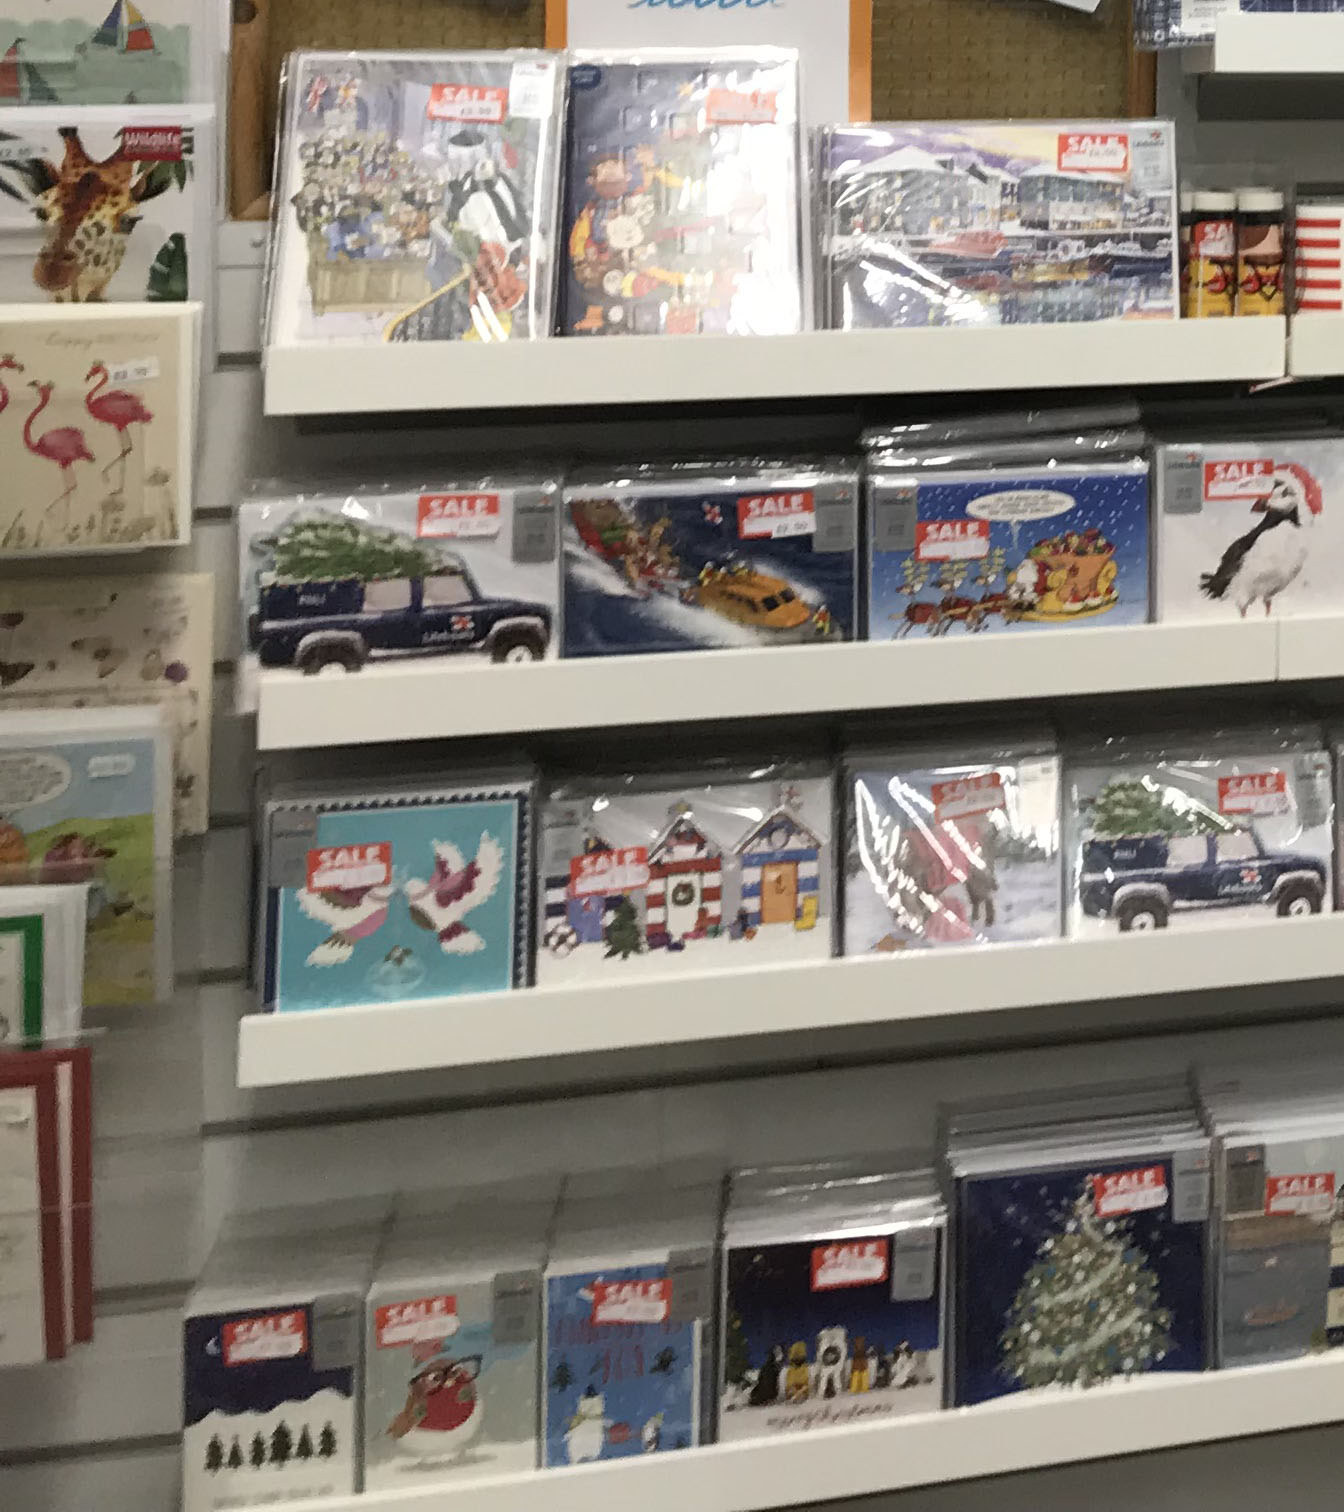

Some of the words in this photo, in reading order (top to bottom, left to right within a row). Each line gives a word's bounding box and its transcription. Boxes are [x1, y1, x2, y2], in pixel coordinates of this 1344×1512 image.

[1213, 464, 1265, 482] SALE
[430, 498, 488, 516] SALE
[747, 496, 803, 515] SALE
[926, 522, 980, 540] SALE
[1226, 776, 1277, 793] SALE
[320, 848, 380, 867] SALE
[579, 851, 638, 872] SALE
[1102, 1173, 1157, 1193] SALE
[1274, 1178, 1327, 1195] SALE
